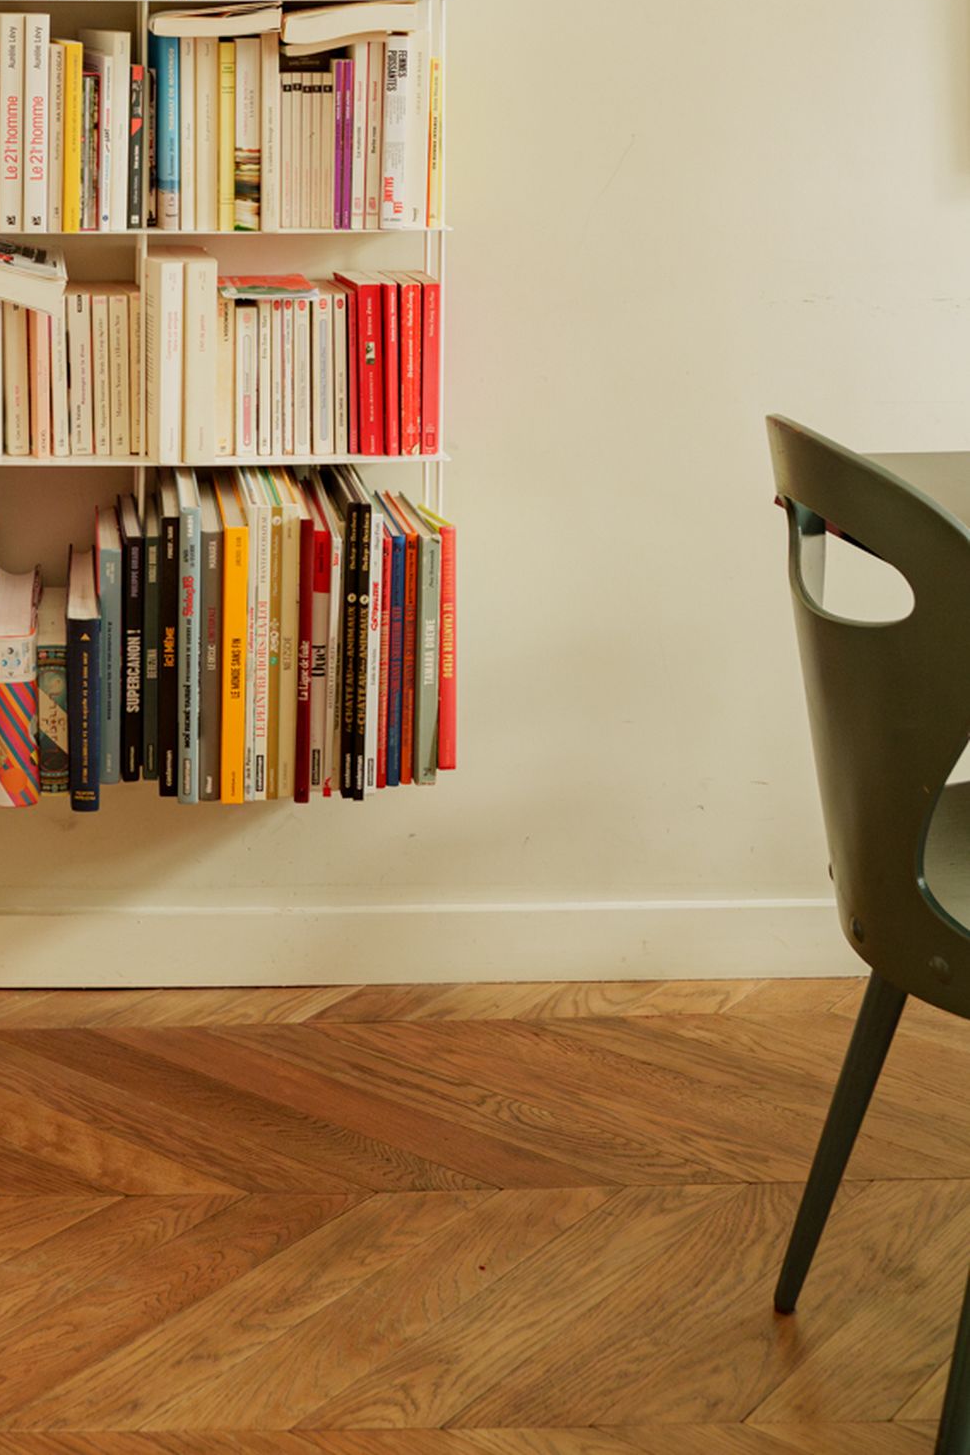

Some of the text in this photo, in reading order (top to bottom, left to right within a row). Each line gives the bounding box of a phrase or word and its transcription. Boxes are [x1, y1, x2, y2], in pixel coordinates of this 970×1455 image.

[7, 26, 17, 69] Aurélie Lévy
[33, 26, 43, 69] Aurélie Lévy
[386, 50, 398, 92] PUISSANTES
[398, 50, 407, 78] FEMMES
[4, 96, 18, 180] Le homme
[30, 96, 43, 180] Le homme
[384, 177, 394, 203] SALAMÉ
[393, 201, 404, 214] LÉA
[163, 626, 176, 667] ici MÊME
[423, 618, 436, 685] TAMARA DREWE
[443, 602, 455, 653] LE CHANTEUR
[126, 638, 140, 713] SUPERCANON
[230, 638, 242, 699] LE MONDE SANS FIN
[255, 600, 268, 738] LE PEINTRE HORS-LA-LOI
[298, 640, 310, 701] La Ligne de fuite
[311, 644, 327, 678] Duel
[344, 606, 357, 724] CHÂTEAU ANIMAUX
[356, 606, 370, 725] CHÂTEAU ANIMAUX
[182, 684, 192, 749] MOI RENÉ TARDI
[165, 749, 173, 786] casterman
